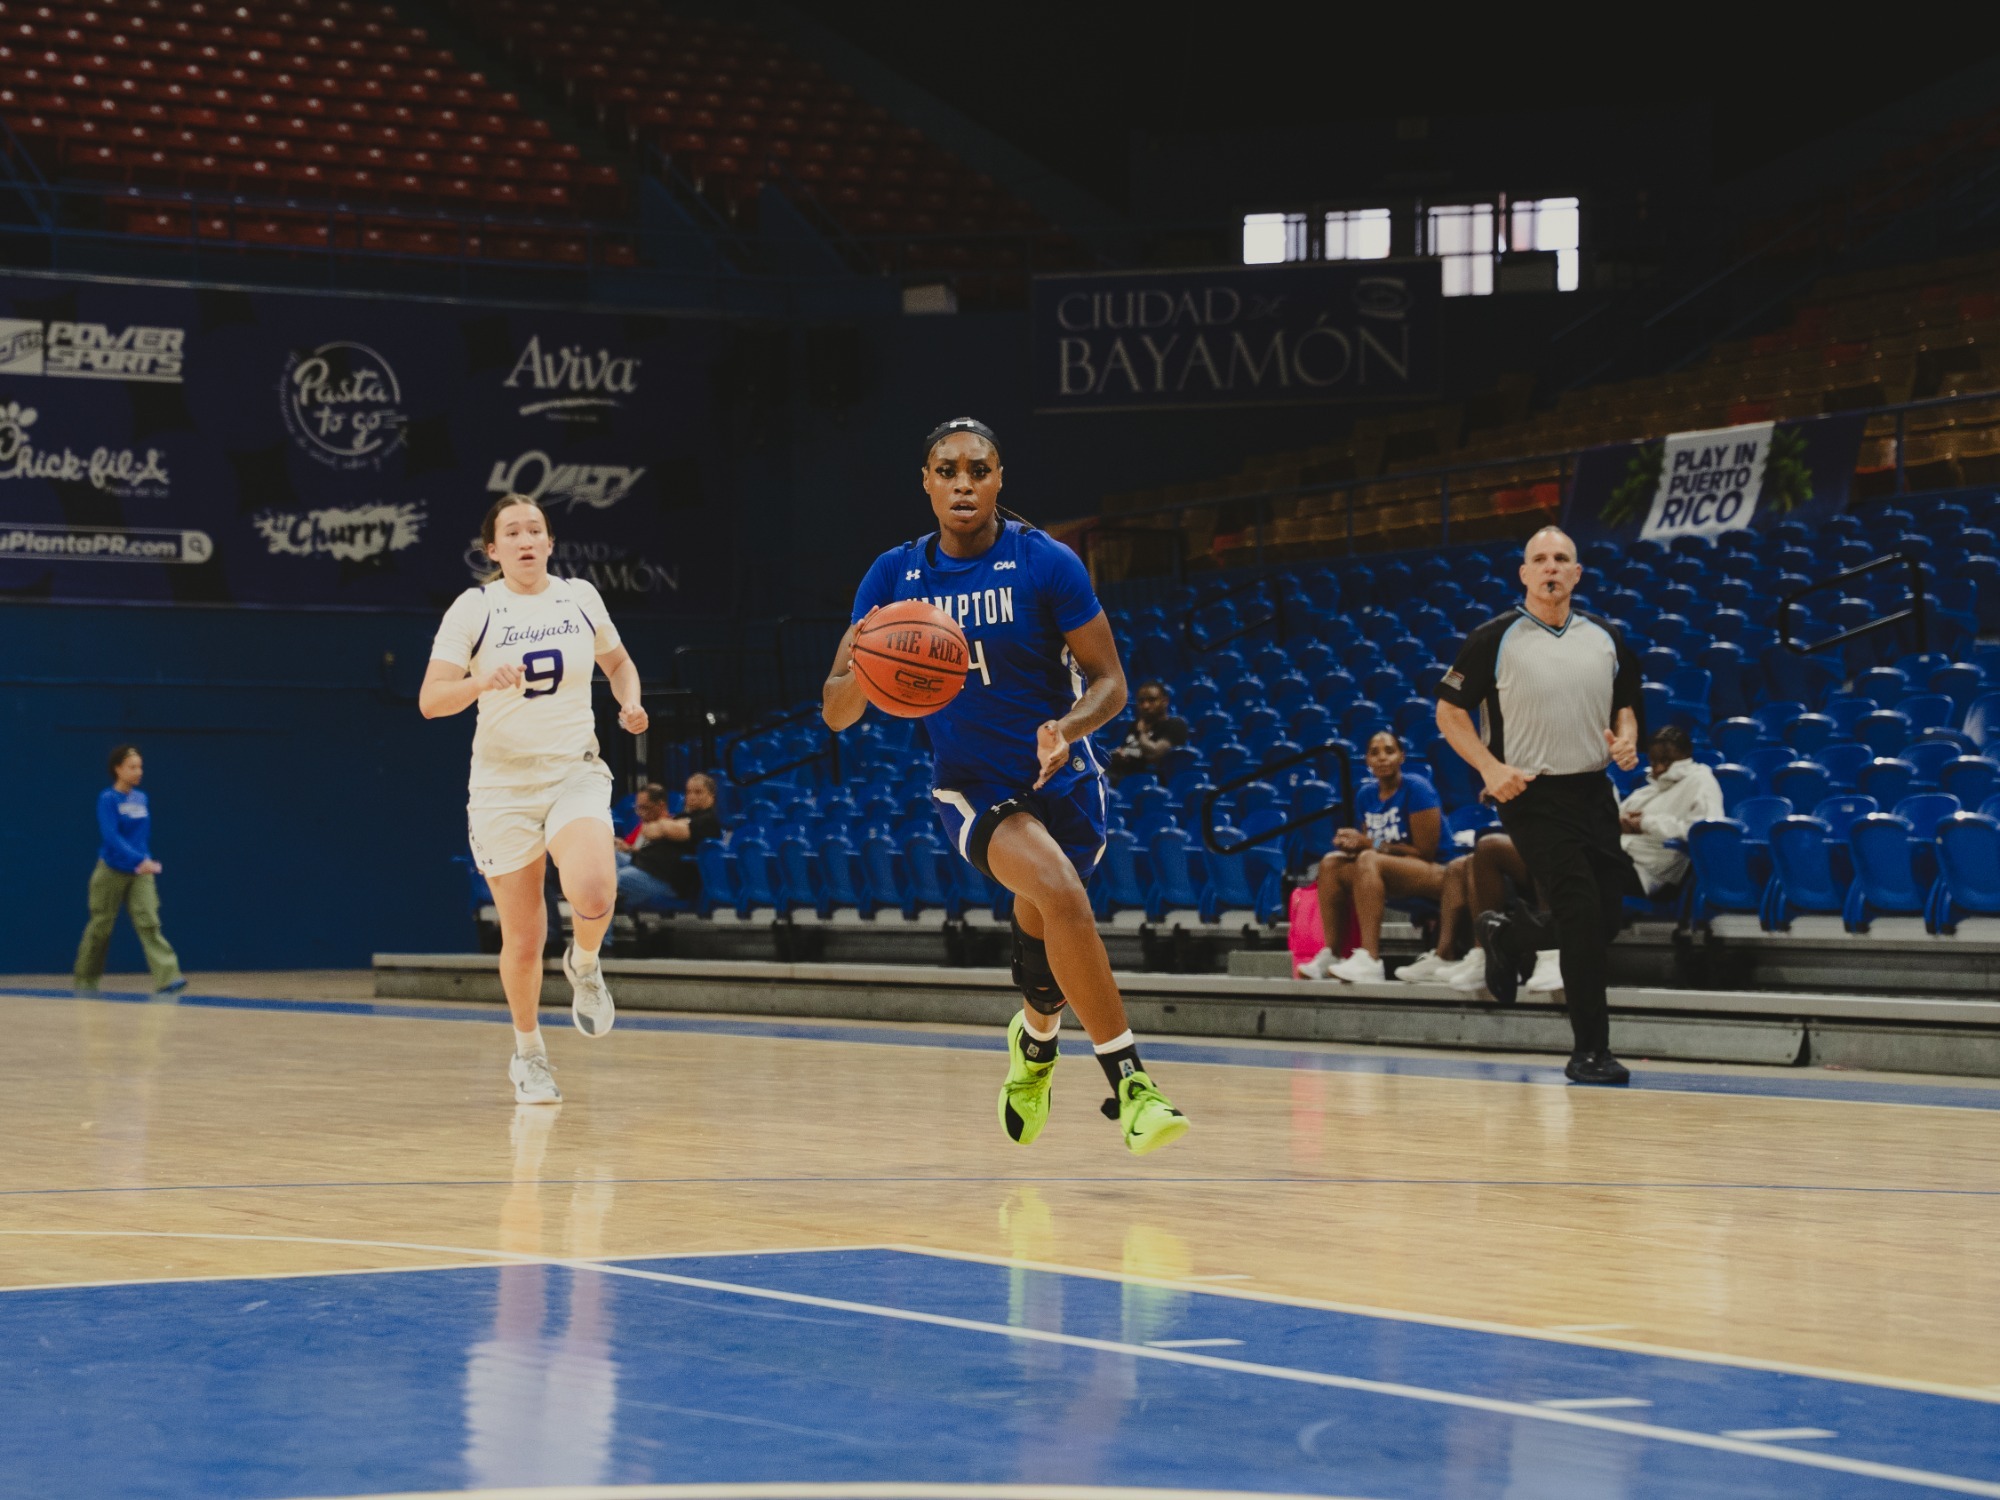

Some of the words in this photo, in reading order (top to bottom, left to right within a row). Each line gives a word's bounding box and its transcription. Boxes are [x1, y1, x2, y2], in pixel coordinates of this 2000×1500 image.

[1057, 287, 1241, 331] CIUDAD
[47, 321, 185, 350] POWER
[47, 348, 183, 375] SPORTS
[503, 334, 636, 393] Aviva
[1058, 313, 1409, 397] BAYAMÓN
[292, 357, 389, 407] Pasta
[313, 405, 345, 437] to
[352, 411, 384, 450] go
[1674, 446, 1728, 471] PLAY
[1734, 442, 1757, 463] IN
[1669, 467, 1750, 495] PUERTO
[1657, 491, 1743, 528] RICO
[288, 515, 396, 550] Churry
[993, 561, 1016, 571] CAA
[907, 587, 1014, 629] MPTON
[496, 619, 580, 648] Ladyjacks
[886, 630, 922, 655] THE
[928, 634, 963, 666] ROCK
[522, 649, 564, 699] 9
